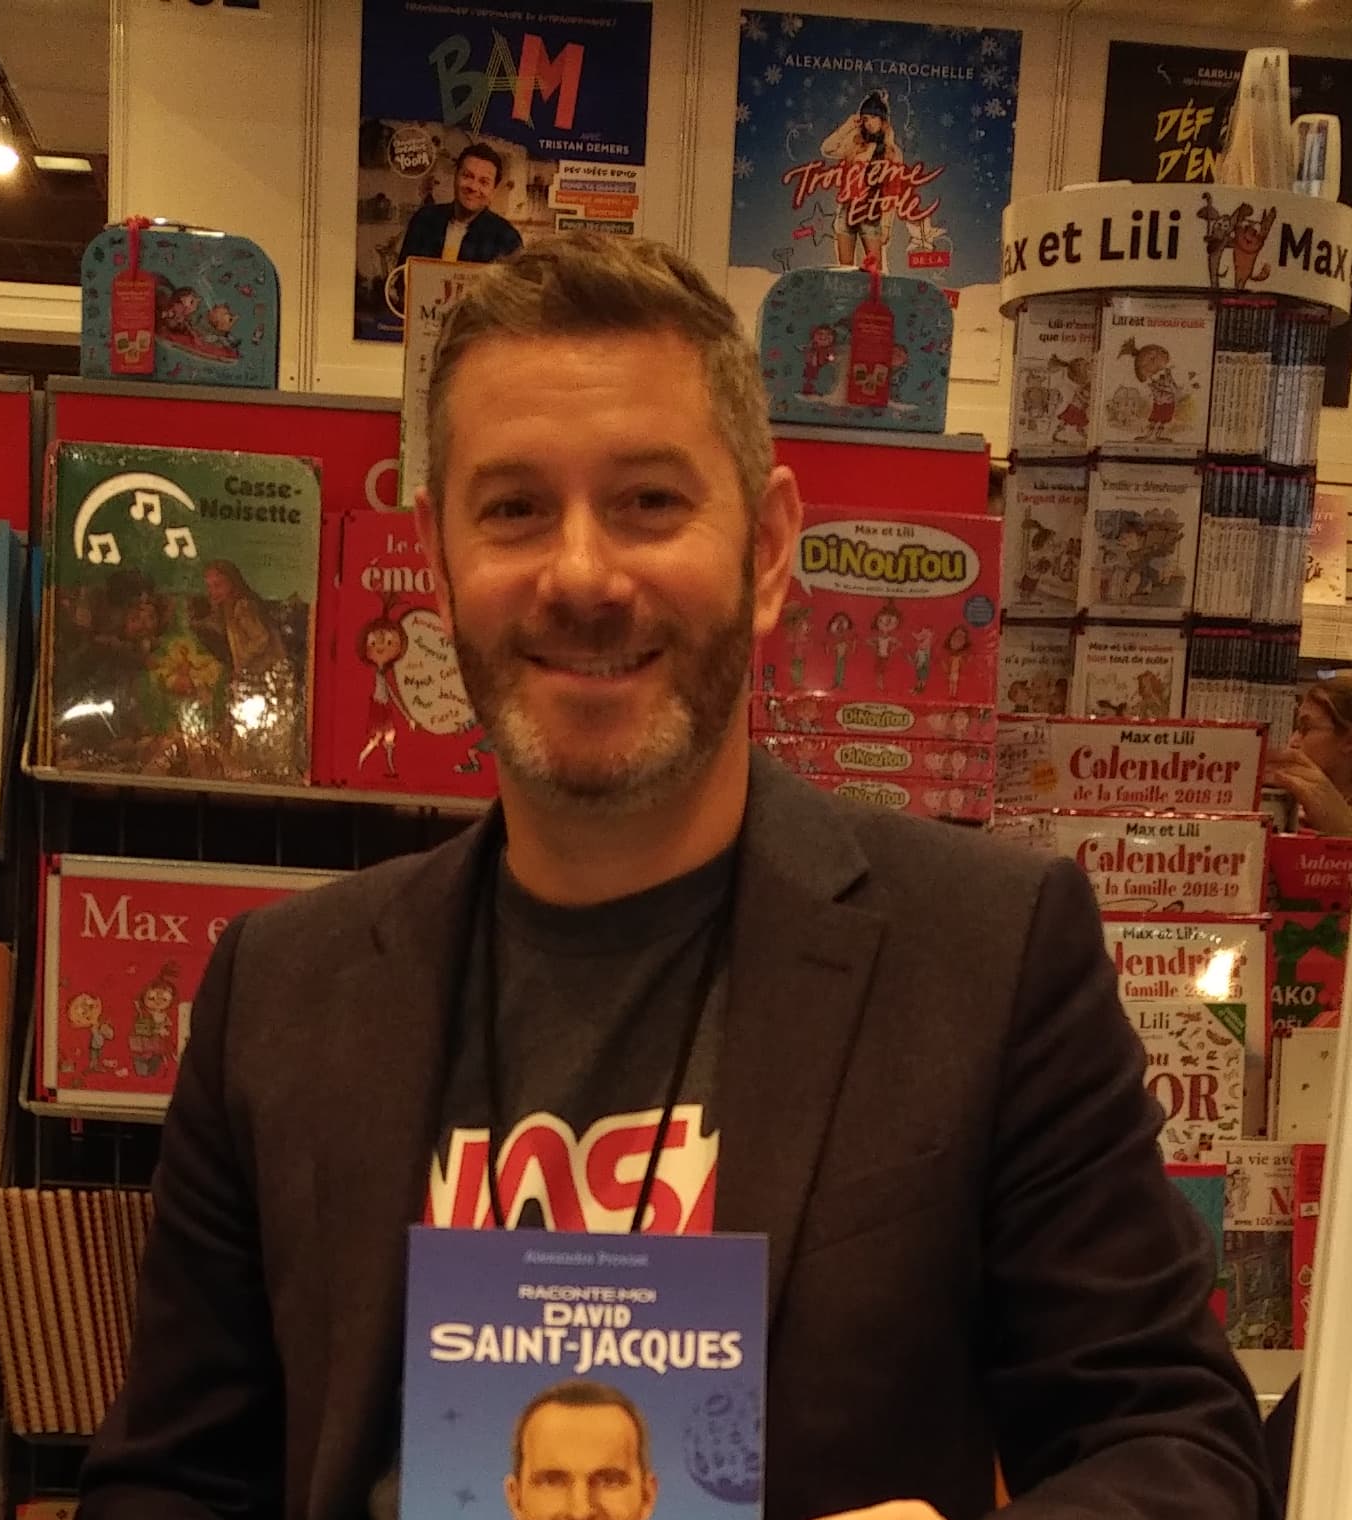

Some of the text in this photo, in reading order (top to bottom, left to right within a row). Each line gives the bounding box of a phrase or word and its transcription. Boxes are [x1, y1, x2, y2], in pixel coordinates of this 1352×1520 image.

[785, 54, 975, 81] ALEXANDRA LAROCHELLE
[428, 27, 585, 138] BAM
[1154, 98, 1216, 143] DÉF
[538, 139, 631, 155] TRISTAN DEMERS
[1156, 142, 1223, 182] D'EN
[1004, 209, 1349, 283] ax et Lili Max
[224, 475, 302, 499] Casse-
[200, 497, 301, 524] Noisette
[361, 557, 436, 593] émo
[1120, 730, 1195, 745] Max et Lili
[1069, 744, 1241, 784] Calendrier
[1073, 785, 1093, 802] de
[1098, 783, 1112, 801] la
[1115, 785, 1170, 804] famille
[1126, 823, 1201, 838] Max et Lili
[1075, 837, 1247, 877] Calendrier
[1105, 878, 1240, 899] la famille 2018-19
[79, 892, 192, 945] Max
[1124, 979, 1180, 998] famille
[1139, 1011, 1171, 1030] Lili
[1148, 1073, 1224, 1123] OR
[1226, 1150, 1243, 1165] La
[1248, 1152, 1269, 1166] vie
[517, 1284, 658, 1304] RACONTE-MOI
[542, 1302, 632, 1329] DAVID
[429, 1323, 744, 1375] SAINT-JACQUES
